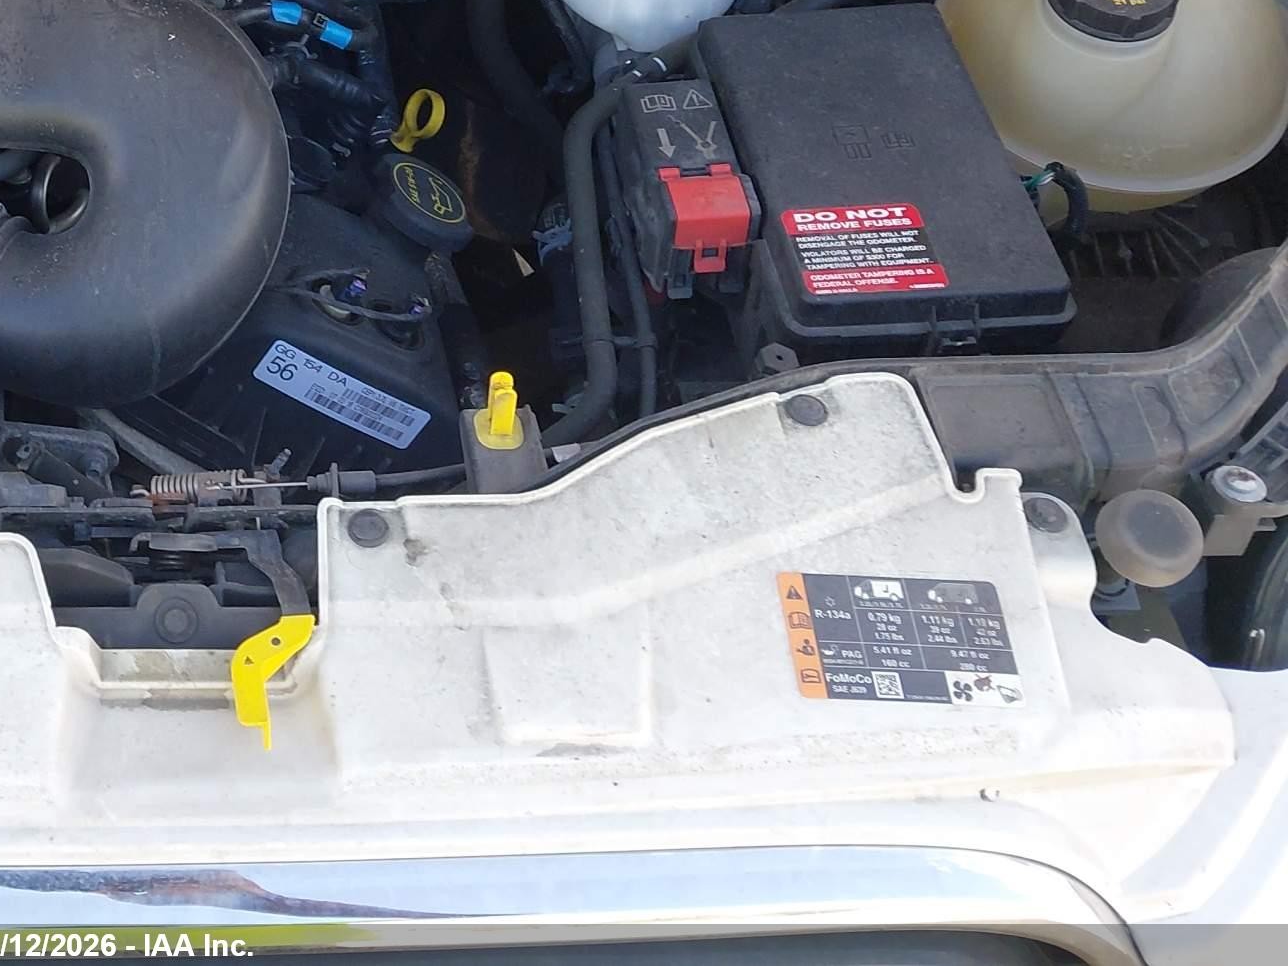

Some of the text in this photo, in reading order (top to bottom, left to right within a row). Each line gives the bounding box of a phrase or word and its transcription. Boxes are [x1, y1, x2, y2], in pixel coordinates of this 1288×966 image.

[793, 207, 906, 223] DO NOT
[796, 218, 912, 232] REMOVE FUSES
[796, 235, 837, 243] REMOVAL
[852, 232, 879, 240] FUSES
[798, 240, 846, 249] DISENGAGE
[802, 250, 849, 258] VIOLATORS
[812, 256, 852, 264] MINIMUM
[806, 262, 856, 270] TAMPERING
[810, 272, 862, 282] ODOMETER
[862, 270, 915, 278] TAMPERING
[813, 278, 899, 288] FEDERAL OFFENSE.
[266, 355, 298, 381] 56
[274, 344, 297, 360] GG
[327, 371, 347, 387] DA
[815, 609, 852, 620] R-134a
[868, 612, 902, 624] 0.79 kg
[921, 615, 955, 628] 1.11 kg
[988, 619, 1000, 630] kg
[887, 624, 898, 632] oz
[841, 650, 863, 659] PAG
[874, 646, 892, 654] 5.41
[900, 648, 912, 656] oz
[825, 672, 872, 684] FoMoCo
[832, 685, 850, 694] SAE
